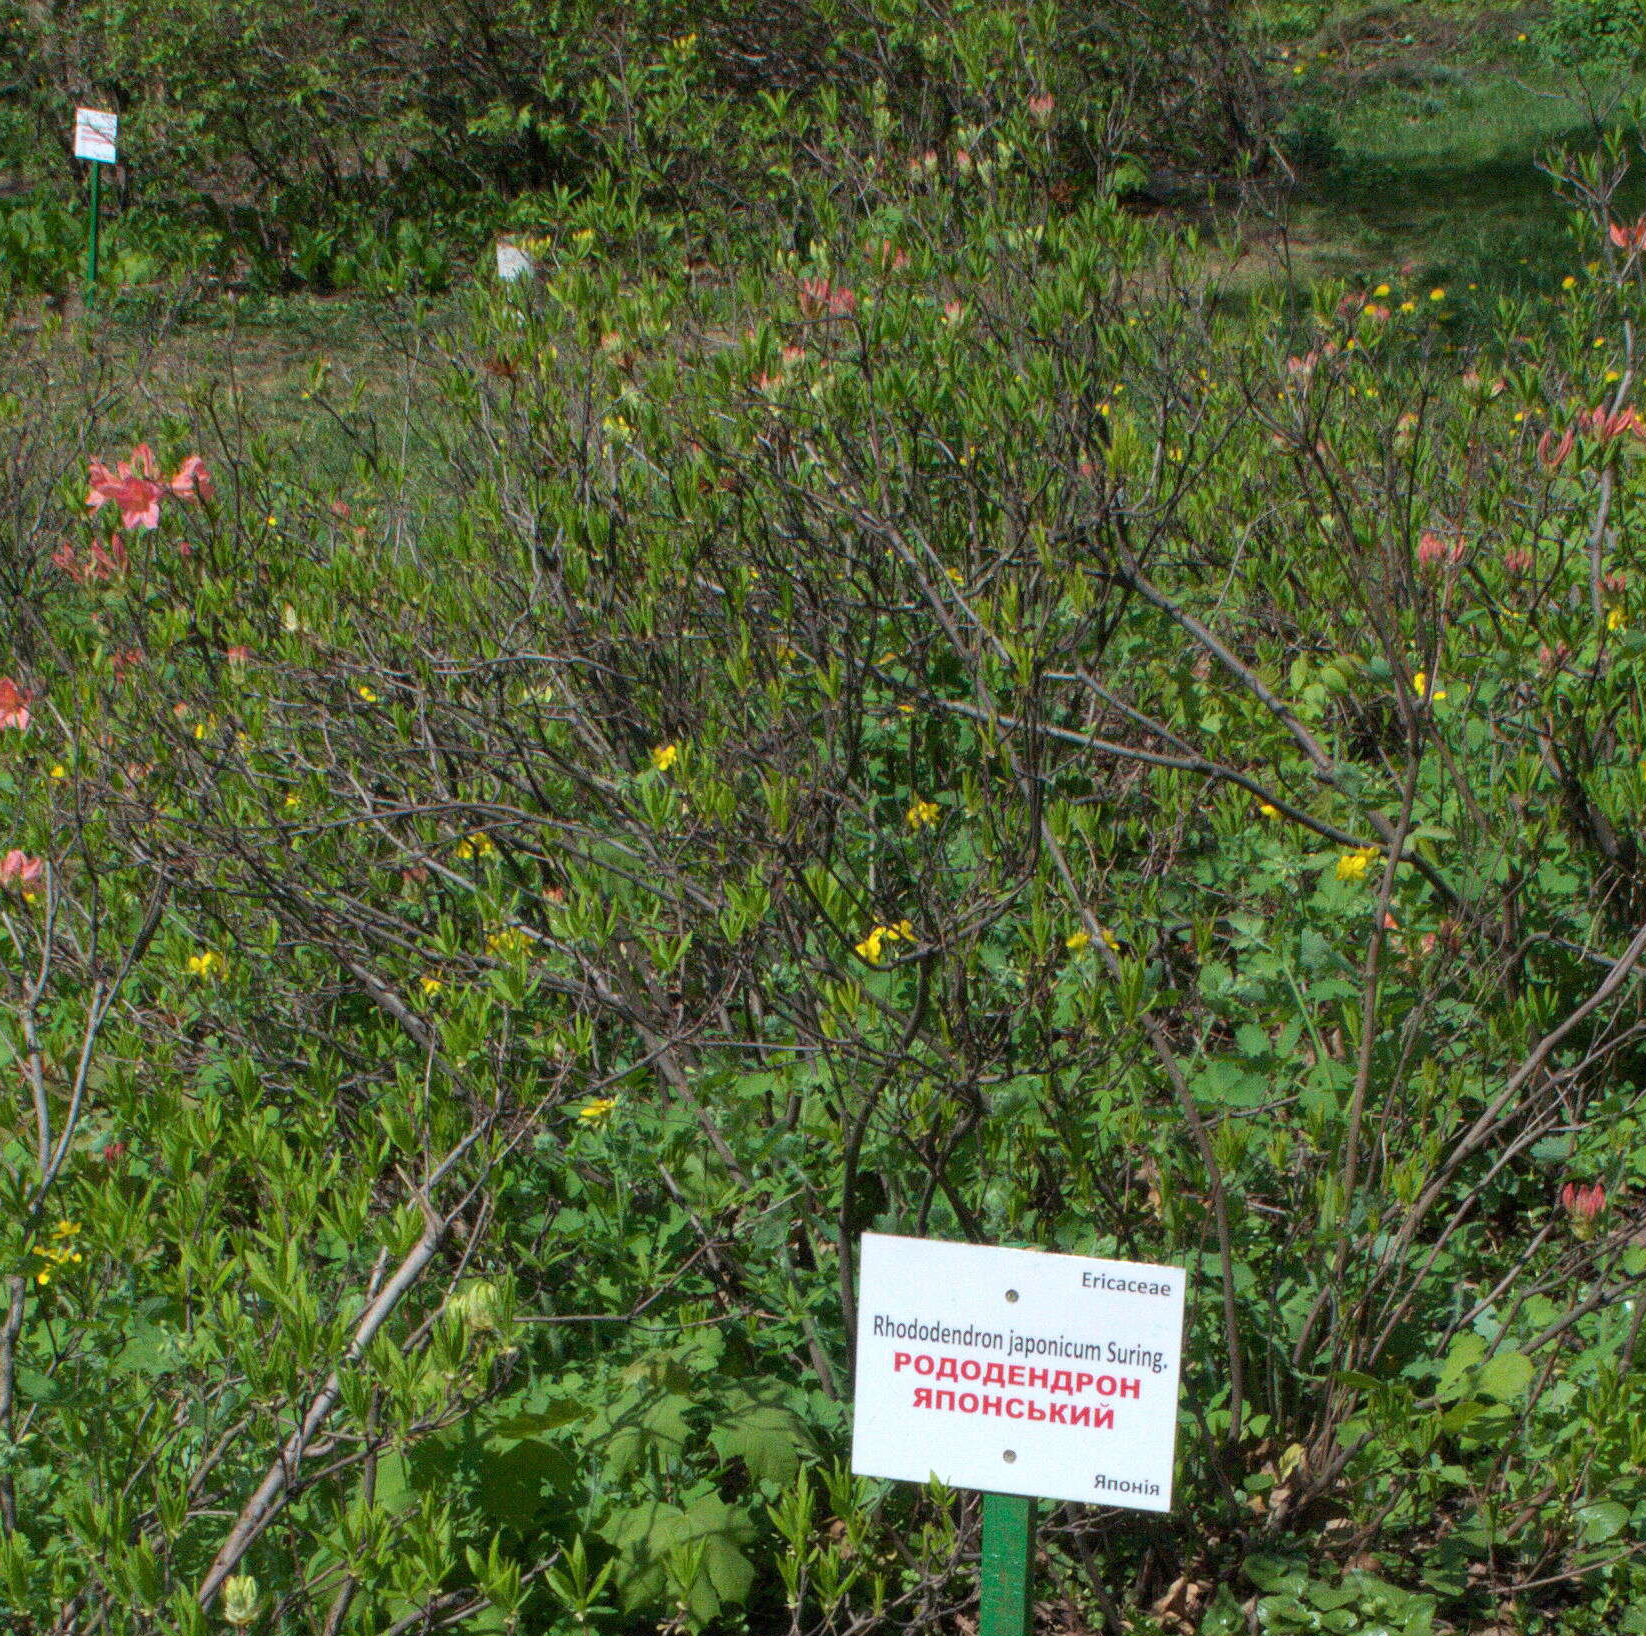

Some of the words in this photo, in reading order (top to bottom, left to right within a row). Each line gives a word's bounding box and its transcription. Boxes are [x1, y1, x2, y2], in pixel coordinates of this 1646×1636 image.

[1081, 1271, 1172, 1297] Ericaceae
[873, 1315, 1003, 1350] Rhododendron
[1007, 1329, 1101, 1362] japonicum
[1106, 1341, 1169, 1374] Suring.
[893, 1351, 1142, 1400] РОДОДЕНДРОН
[912, 1387, 1115, 1430] ЯПОНСЬКИЙ
[1093, 1474, 1161, 1497] Японія
